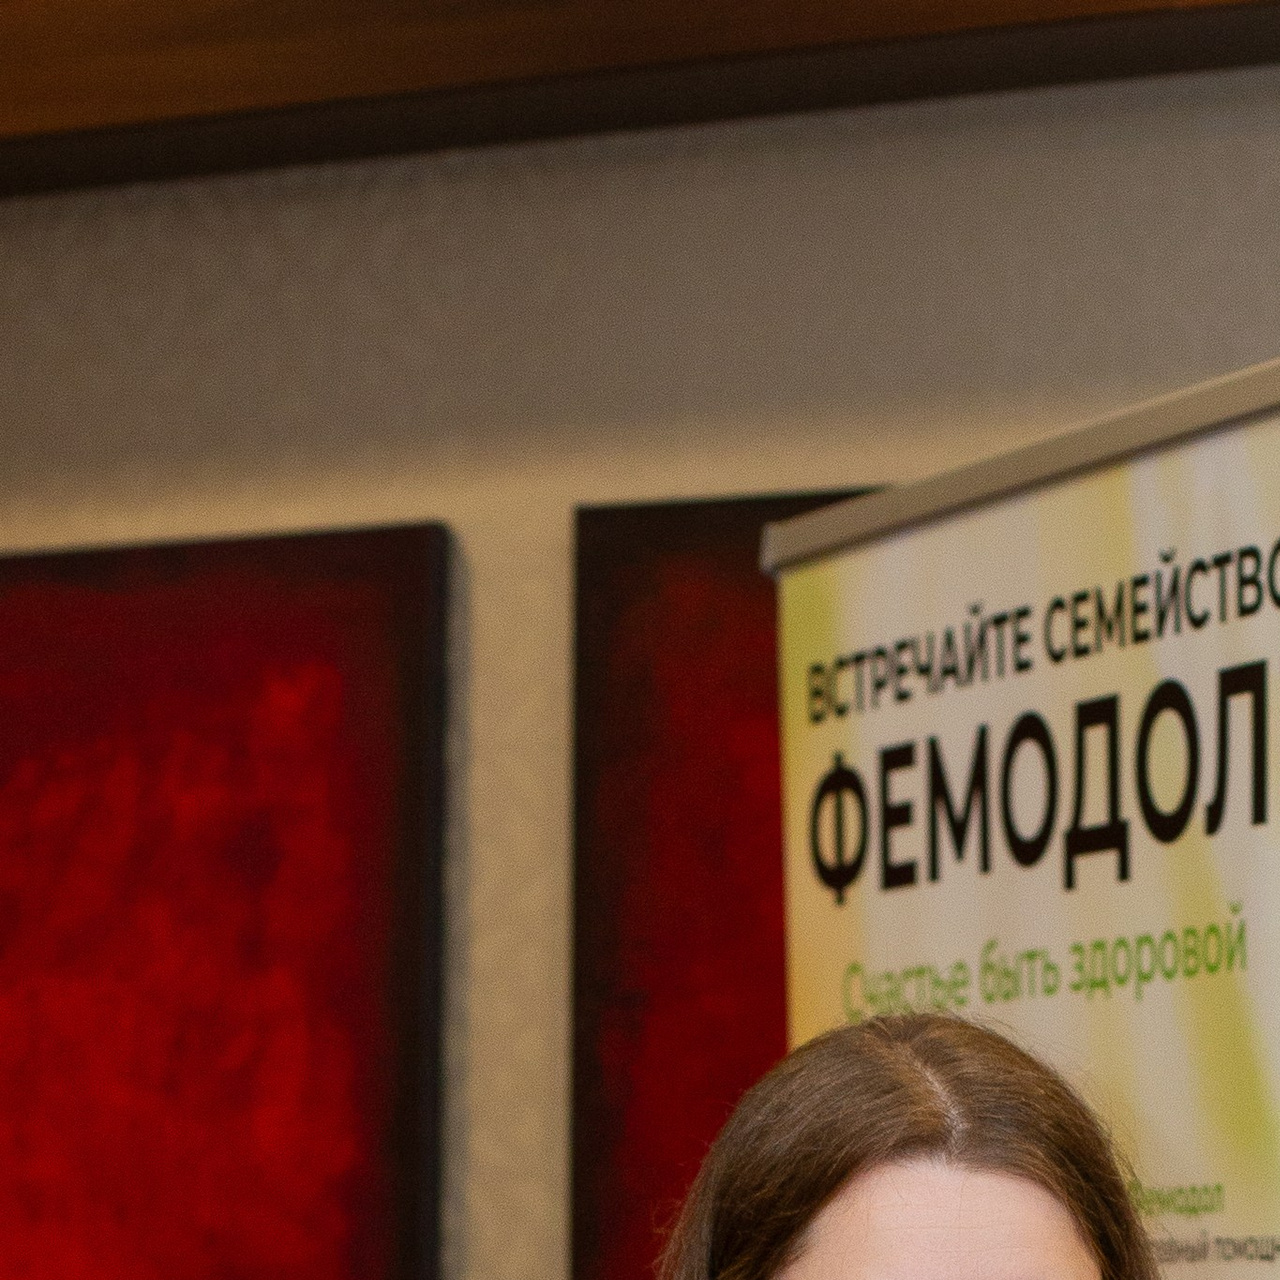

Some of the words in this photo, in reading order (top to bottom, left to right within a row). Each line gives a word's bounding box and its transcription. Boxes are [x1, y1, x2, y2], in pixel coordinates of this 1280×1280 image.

[807, 601, 1033, 725] ВСТРЕЧАЙТЕ
[842, 957, 970, 1022] Счастье
[981, 939, 1062, 1005] быть
[1068, 902, 1249, 1001] здоровой
